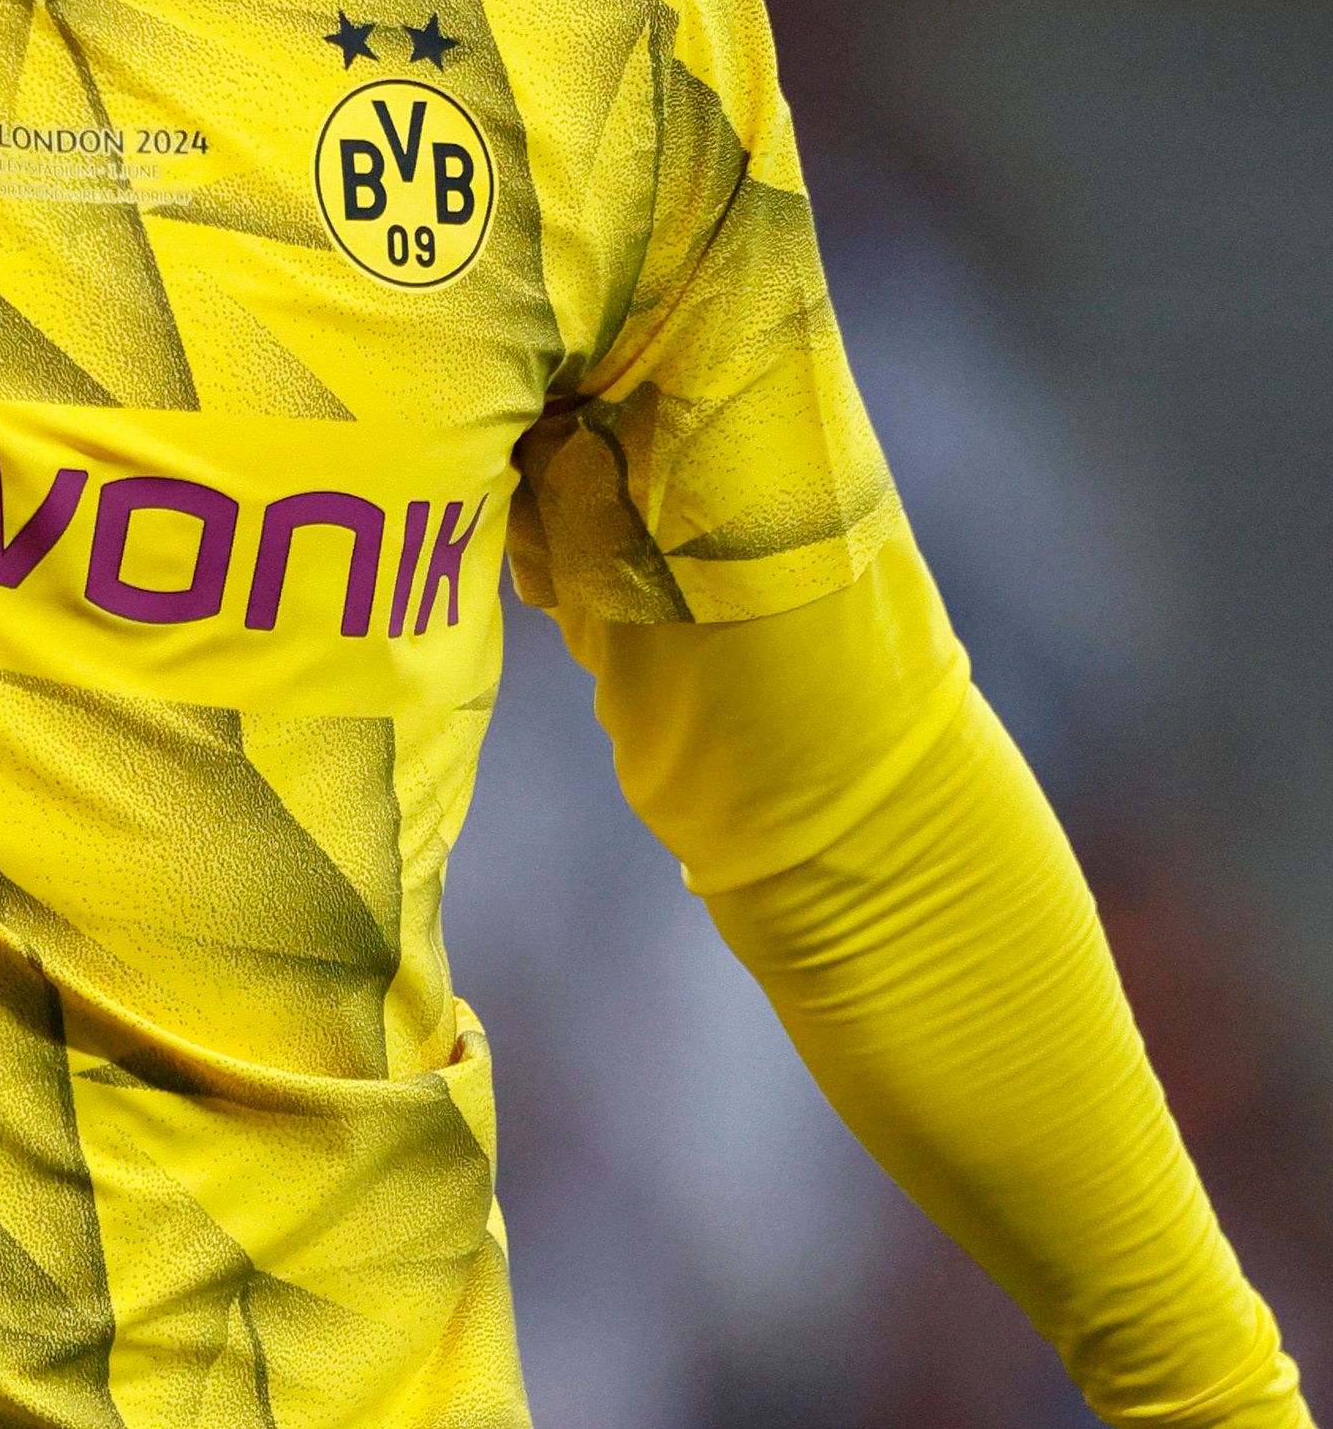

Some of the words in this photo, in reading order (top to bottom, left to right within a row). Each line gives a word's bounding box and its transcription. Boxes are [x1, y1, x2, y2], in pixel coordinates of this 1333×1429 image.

[137, 129, 209, 155] 2024
[339, 100, 475, 225] BVB
[387, 224, 435, 268] 09
